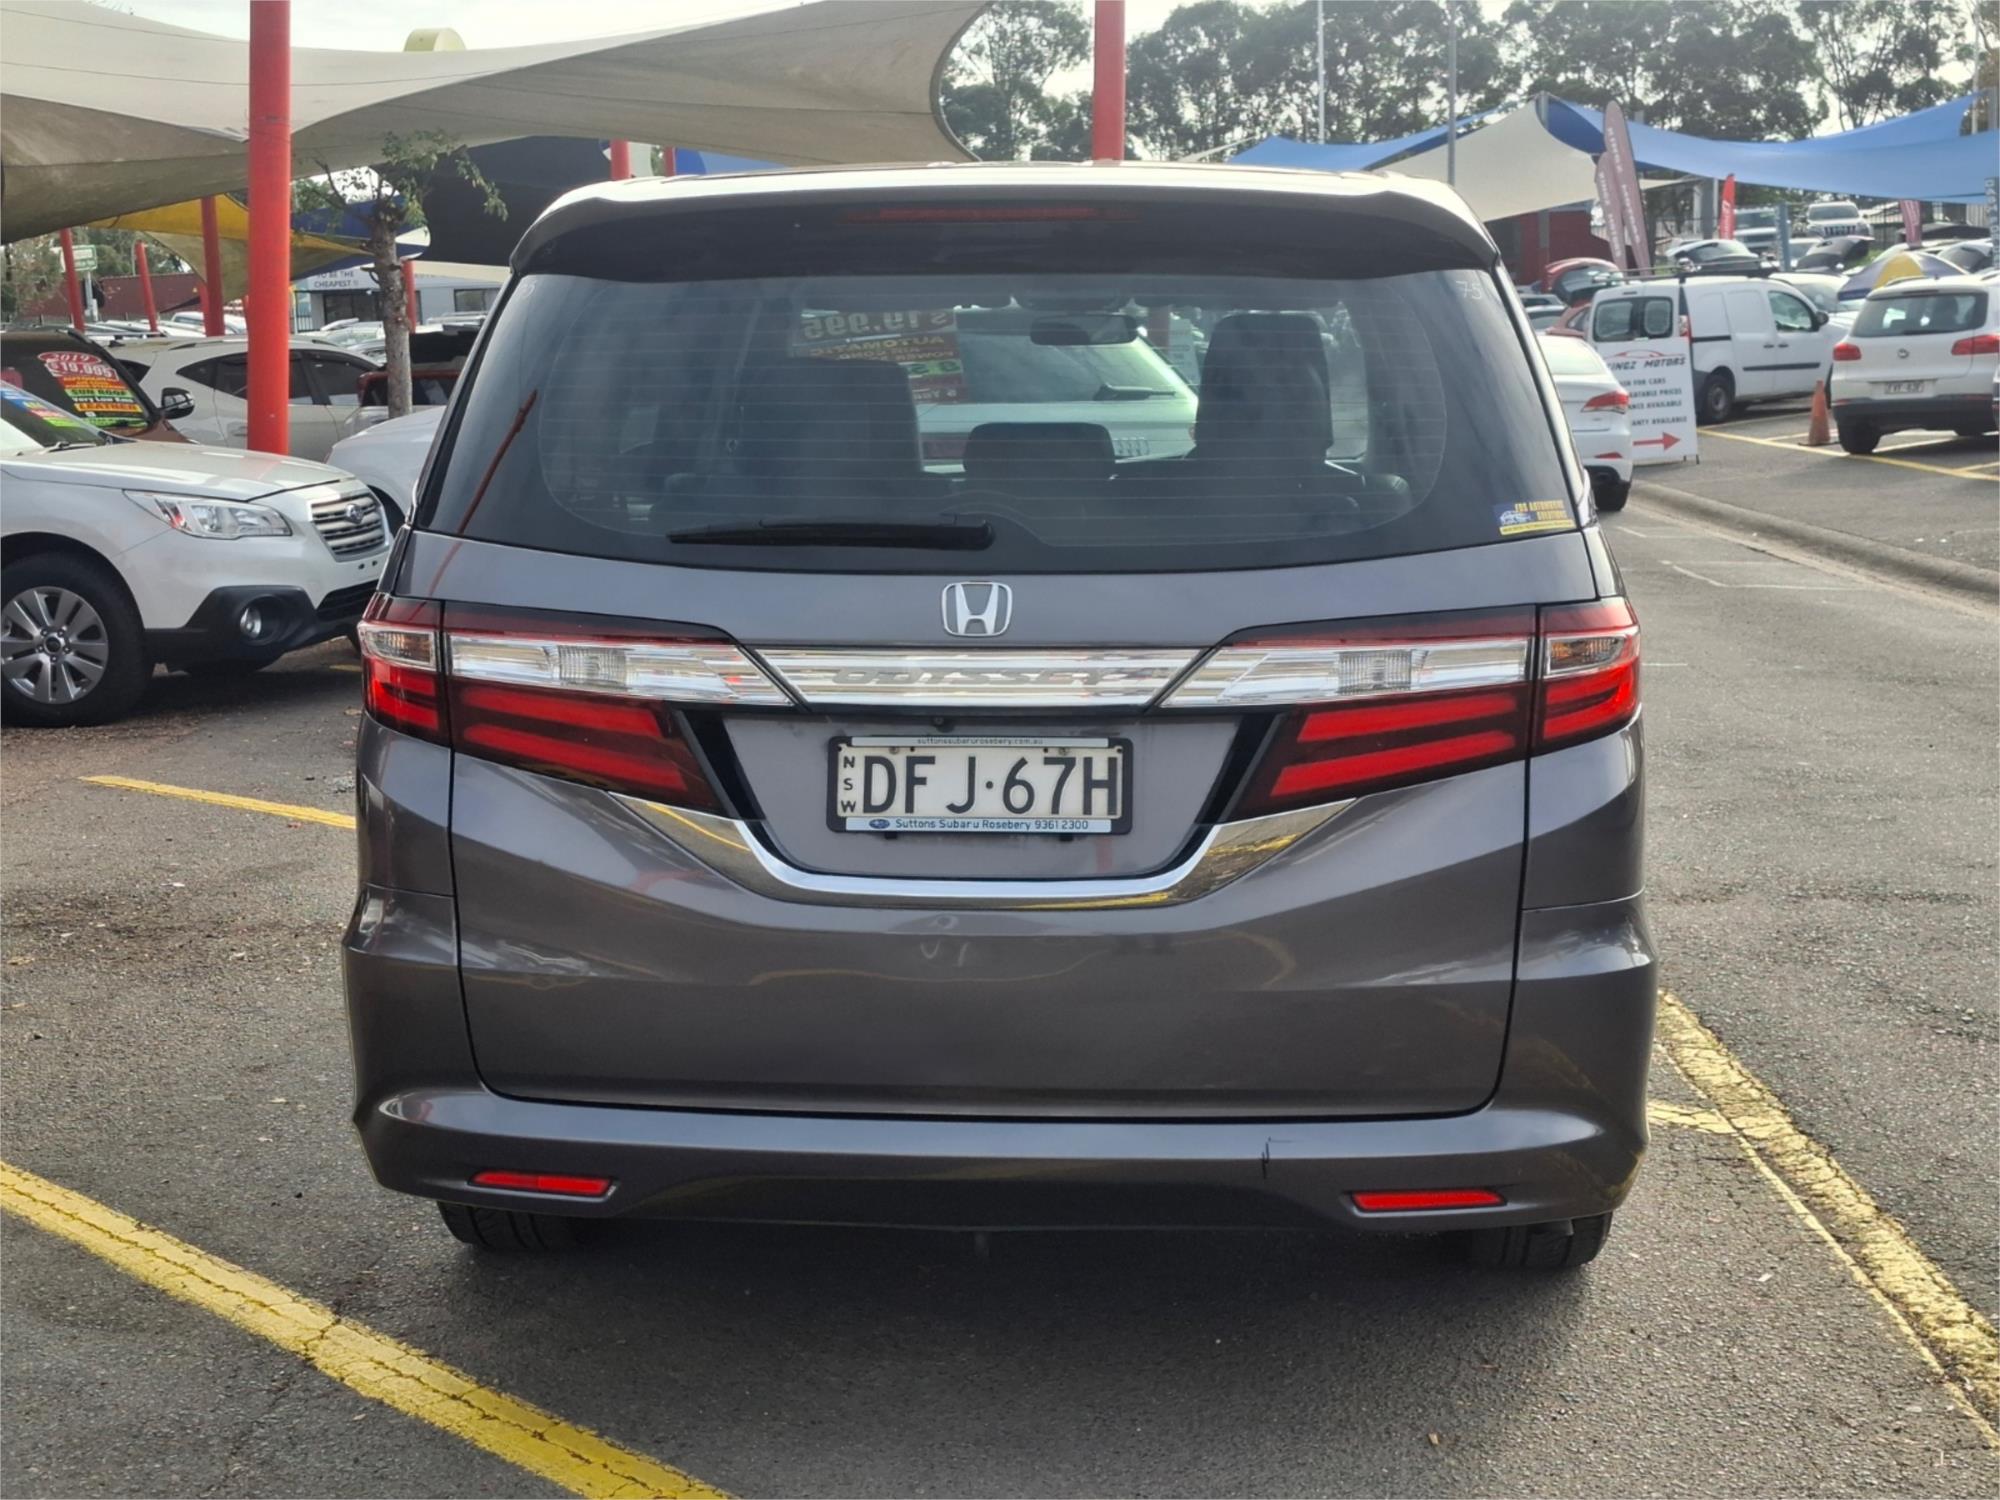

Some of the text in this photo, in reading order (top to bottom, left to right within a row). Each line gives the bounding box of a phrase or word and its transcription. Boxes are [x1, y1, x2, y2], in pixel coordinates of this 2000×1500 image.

[1643, 357, 1686, 369] MOTORS
[895, 818, 1089, 832] Suttons Subaru Rosebery 9361 2300
